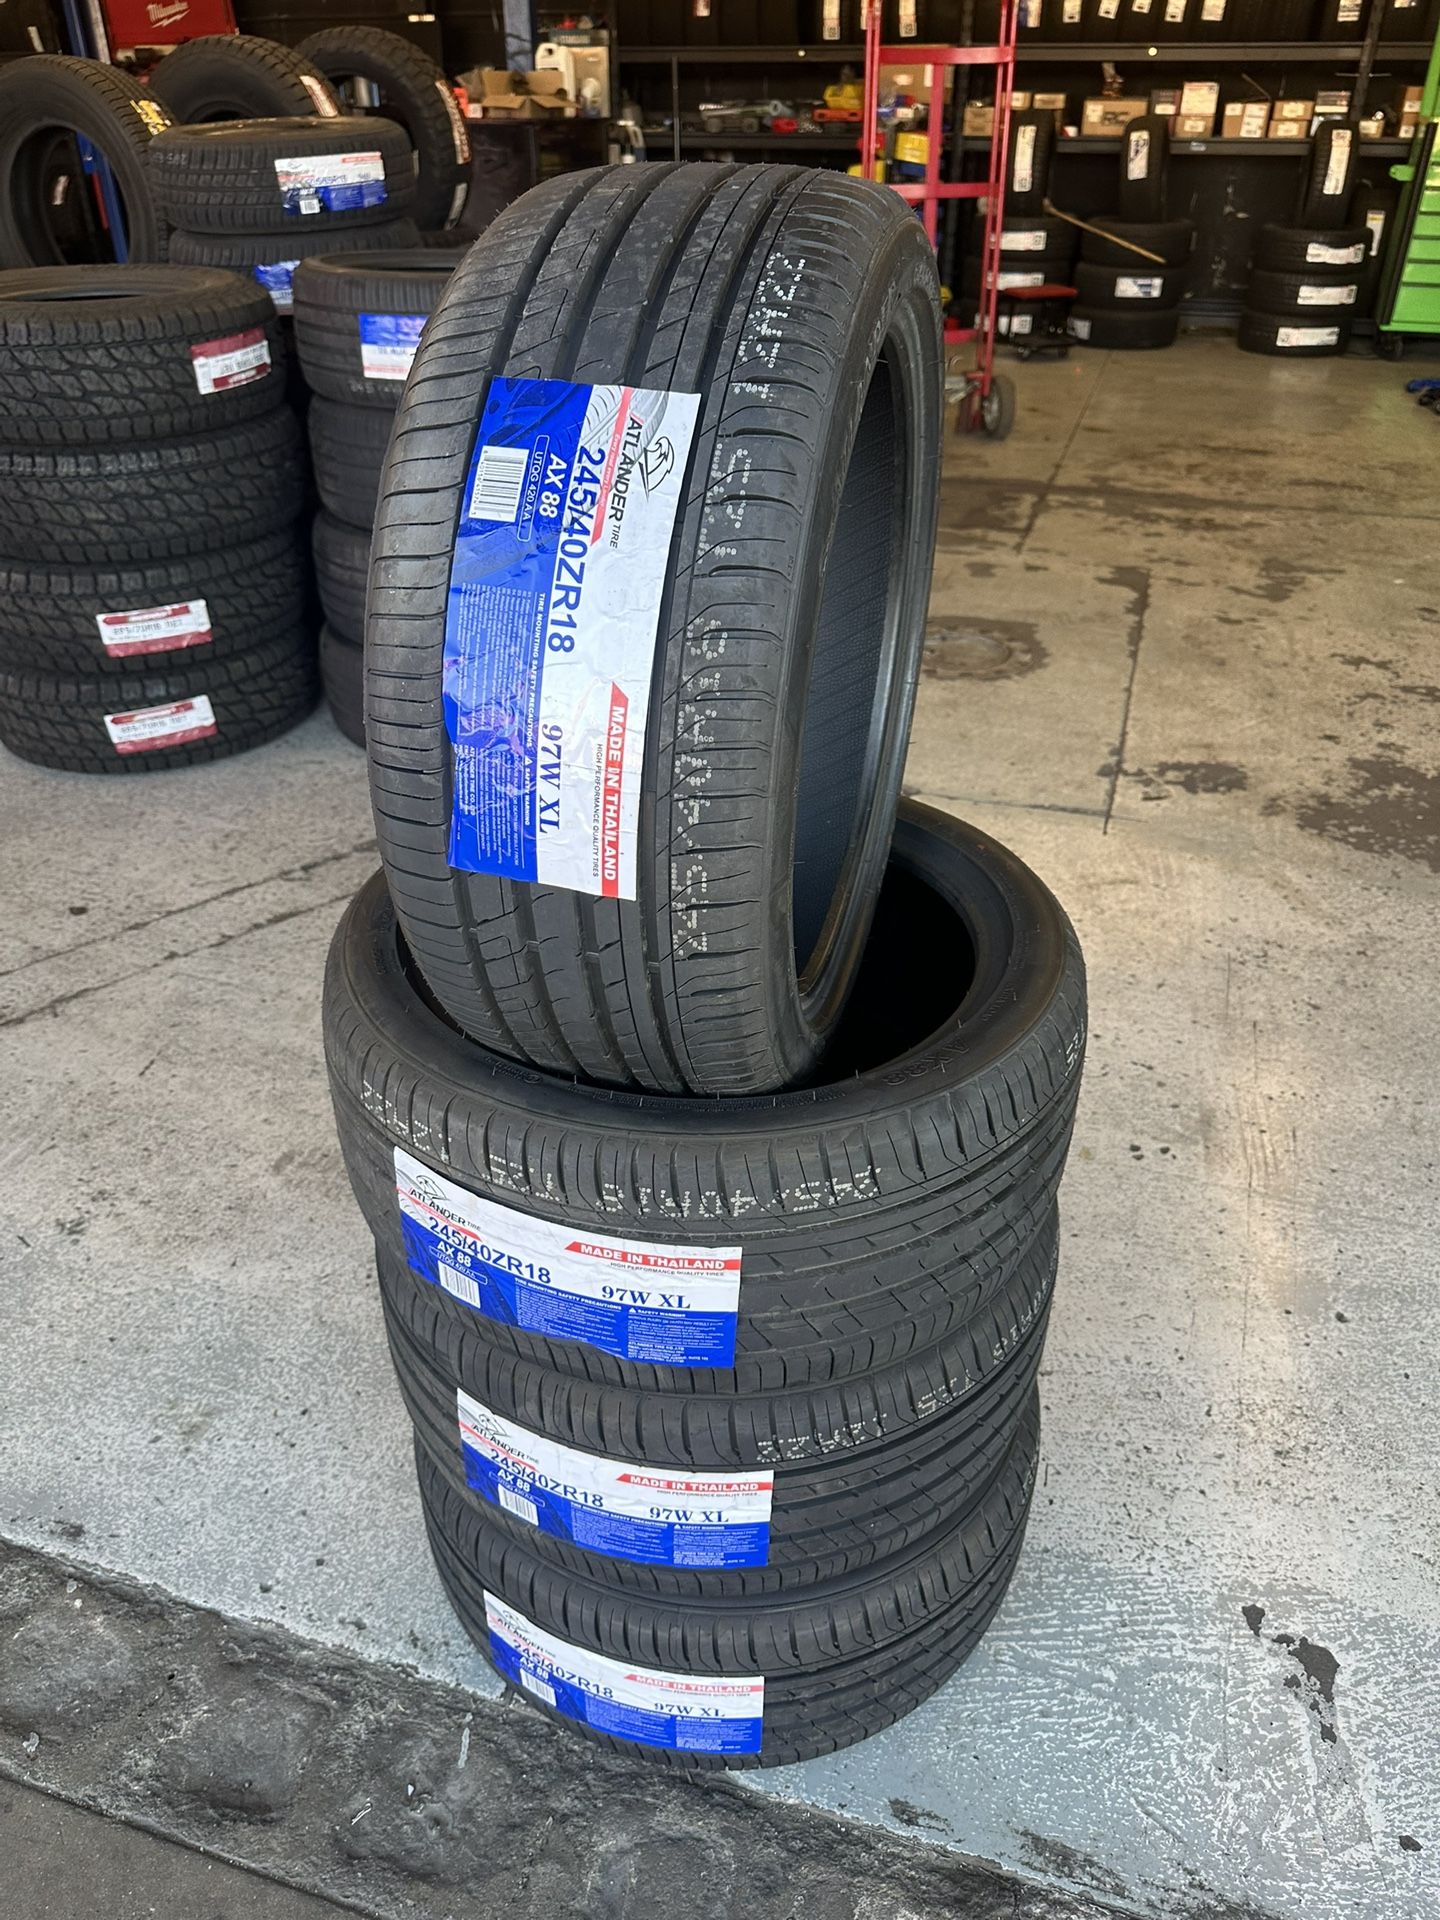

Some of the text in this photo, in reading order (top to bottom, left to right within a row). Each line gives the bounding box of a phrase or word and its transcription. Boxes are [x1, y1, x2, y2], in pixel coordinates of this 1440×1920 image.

[530, 451, 544, 482] UTQG
[609, 414, 643, 549] ATLANDER TIRE
[526, 484, 537, 503] 420
[538, 452, 568, 518] AX 88
[547, 445, 606, 653] 245/40ZR18
[526, 593, 546, 748] TIRE MOUNTING SAFETY PRECAUTIONS
[539, 723, 563, 834] 97W XL
[603, 705, 625, 881] MADE IN THAILAND
[592, 743, 604, 877] HIGH PERFORMANCE QUALITY TIRES
[410, 1187, 466, 1227] ATLANDER
[467, 1220, 481, 1231] TIRE
[428, 1215, 552, 1284] 245/40ZR18
[436, 1240, 472, 1268] AX 88
[580, 1244, 725, 1270] MADE IN THAILAND
[610, 1261, 626, 1269] HIGH
[627, 1264, 675, 1276] PERFORMANCE
[558, 1290, 579, 1303] SAFETY
[580, 1297, 622, 1311] PRECAUTIONS
[601, 1285, 691, 1309] 97W XL
[472, 1423, 526, 1460] ATLANDER
[491, 1448, 604, 1508] 245/40ZR18
[497, 1469, 531, 1493] AX 88
[630, 1475, 759, 1491] MADE IN THAILAND
[649, 1507, 729, 1523] 97W XL
[636, 1676, 671, 1688] MADE
[689, 1684, 752, 1693] THAILAND
[654, 1702, 725, 1717] 97W XL
